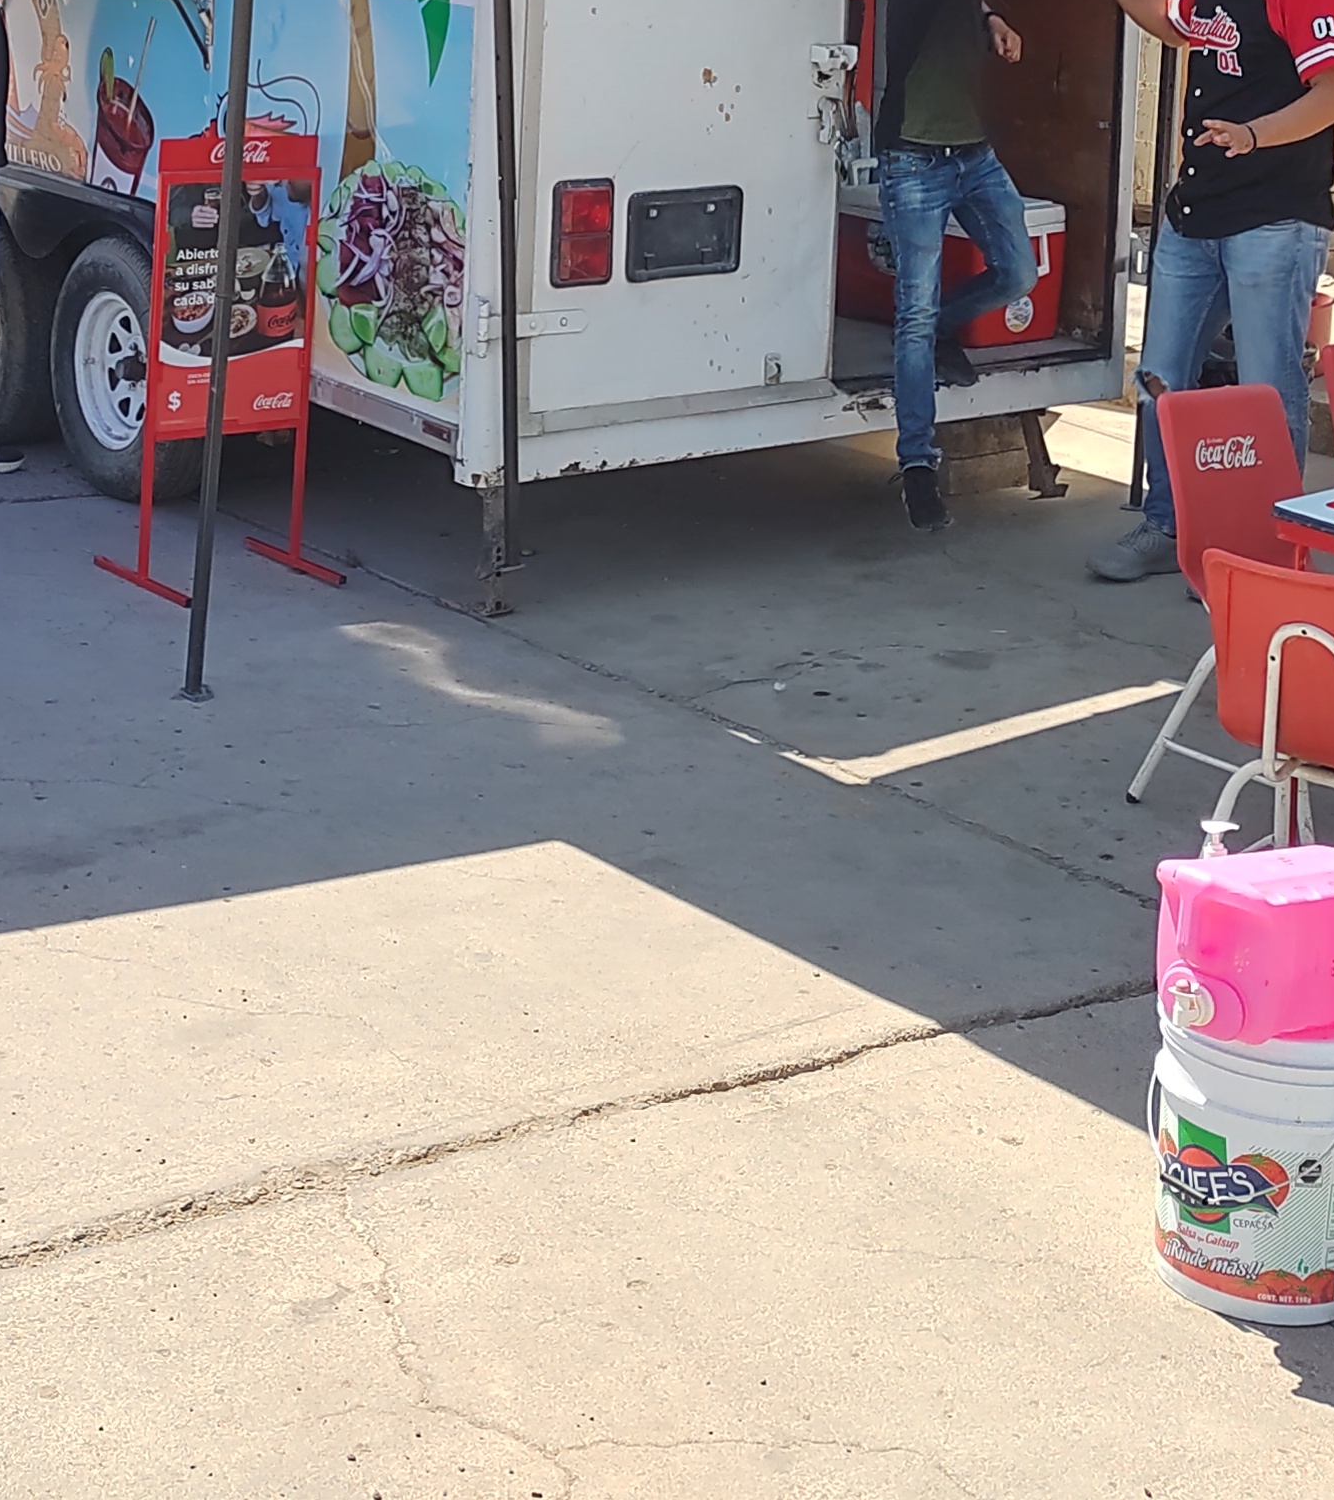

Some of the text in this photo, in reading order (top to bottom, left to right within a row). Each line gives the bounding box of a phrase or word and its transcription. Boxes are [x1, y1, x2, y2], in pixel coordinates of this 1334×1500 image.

[1217, 50, 1243, 77] 01
[175, 267, 184, 276] a
[174, 281, 189, 291] su
[173, 294, 204, 307] cada
[168, 390, 182, 412] $
[253, 392, 294, 410] Coca-Cola
[1195, 435, 1256, 471] Coca-Cola
[1177, 1222, 1240, 1253] Salsa Catsup
